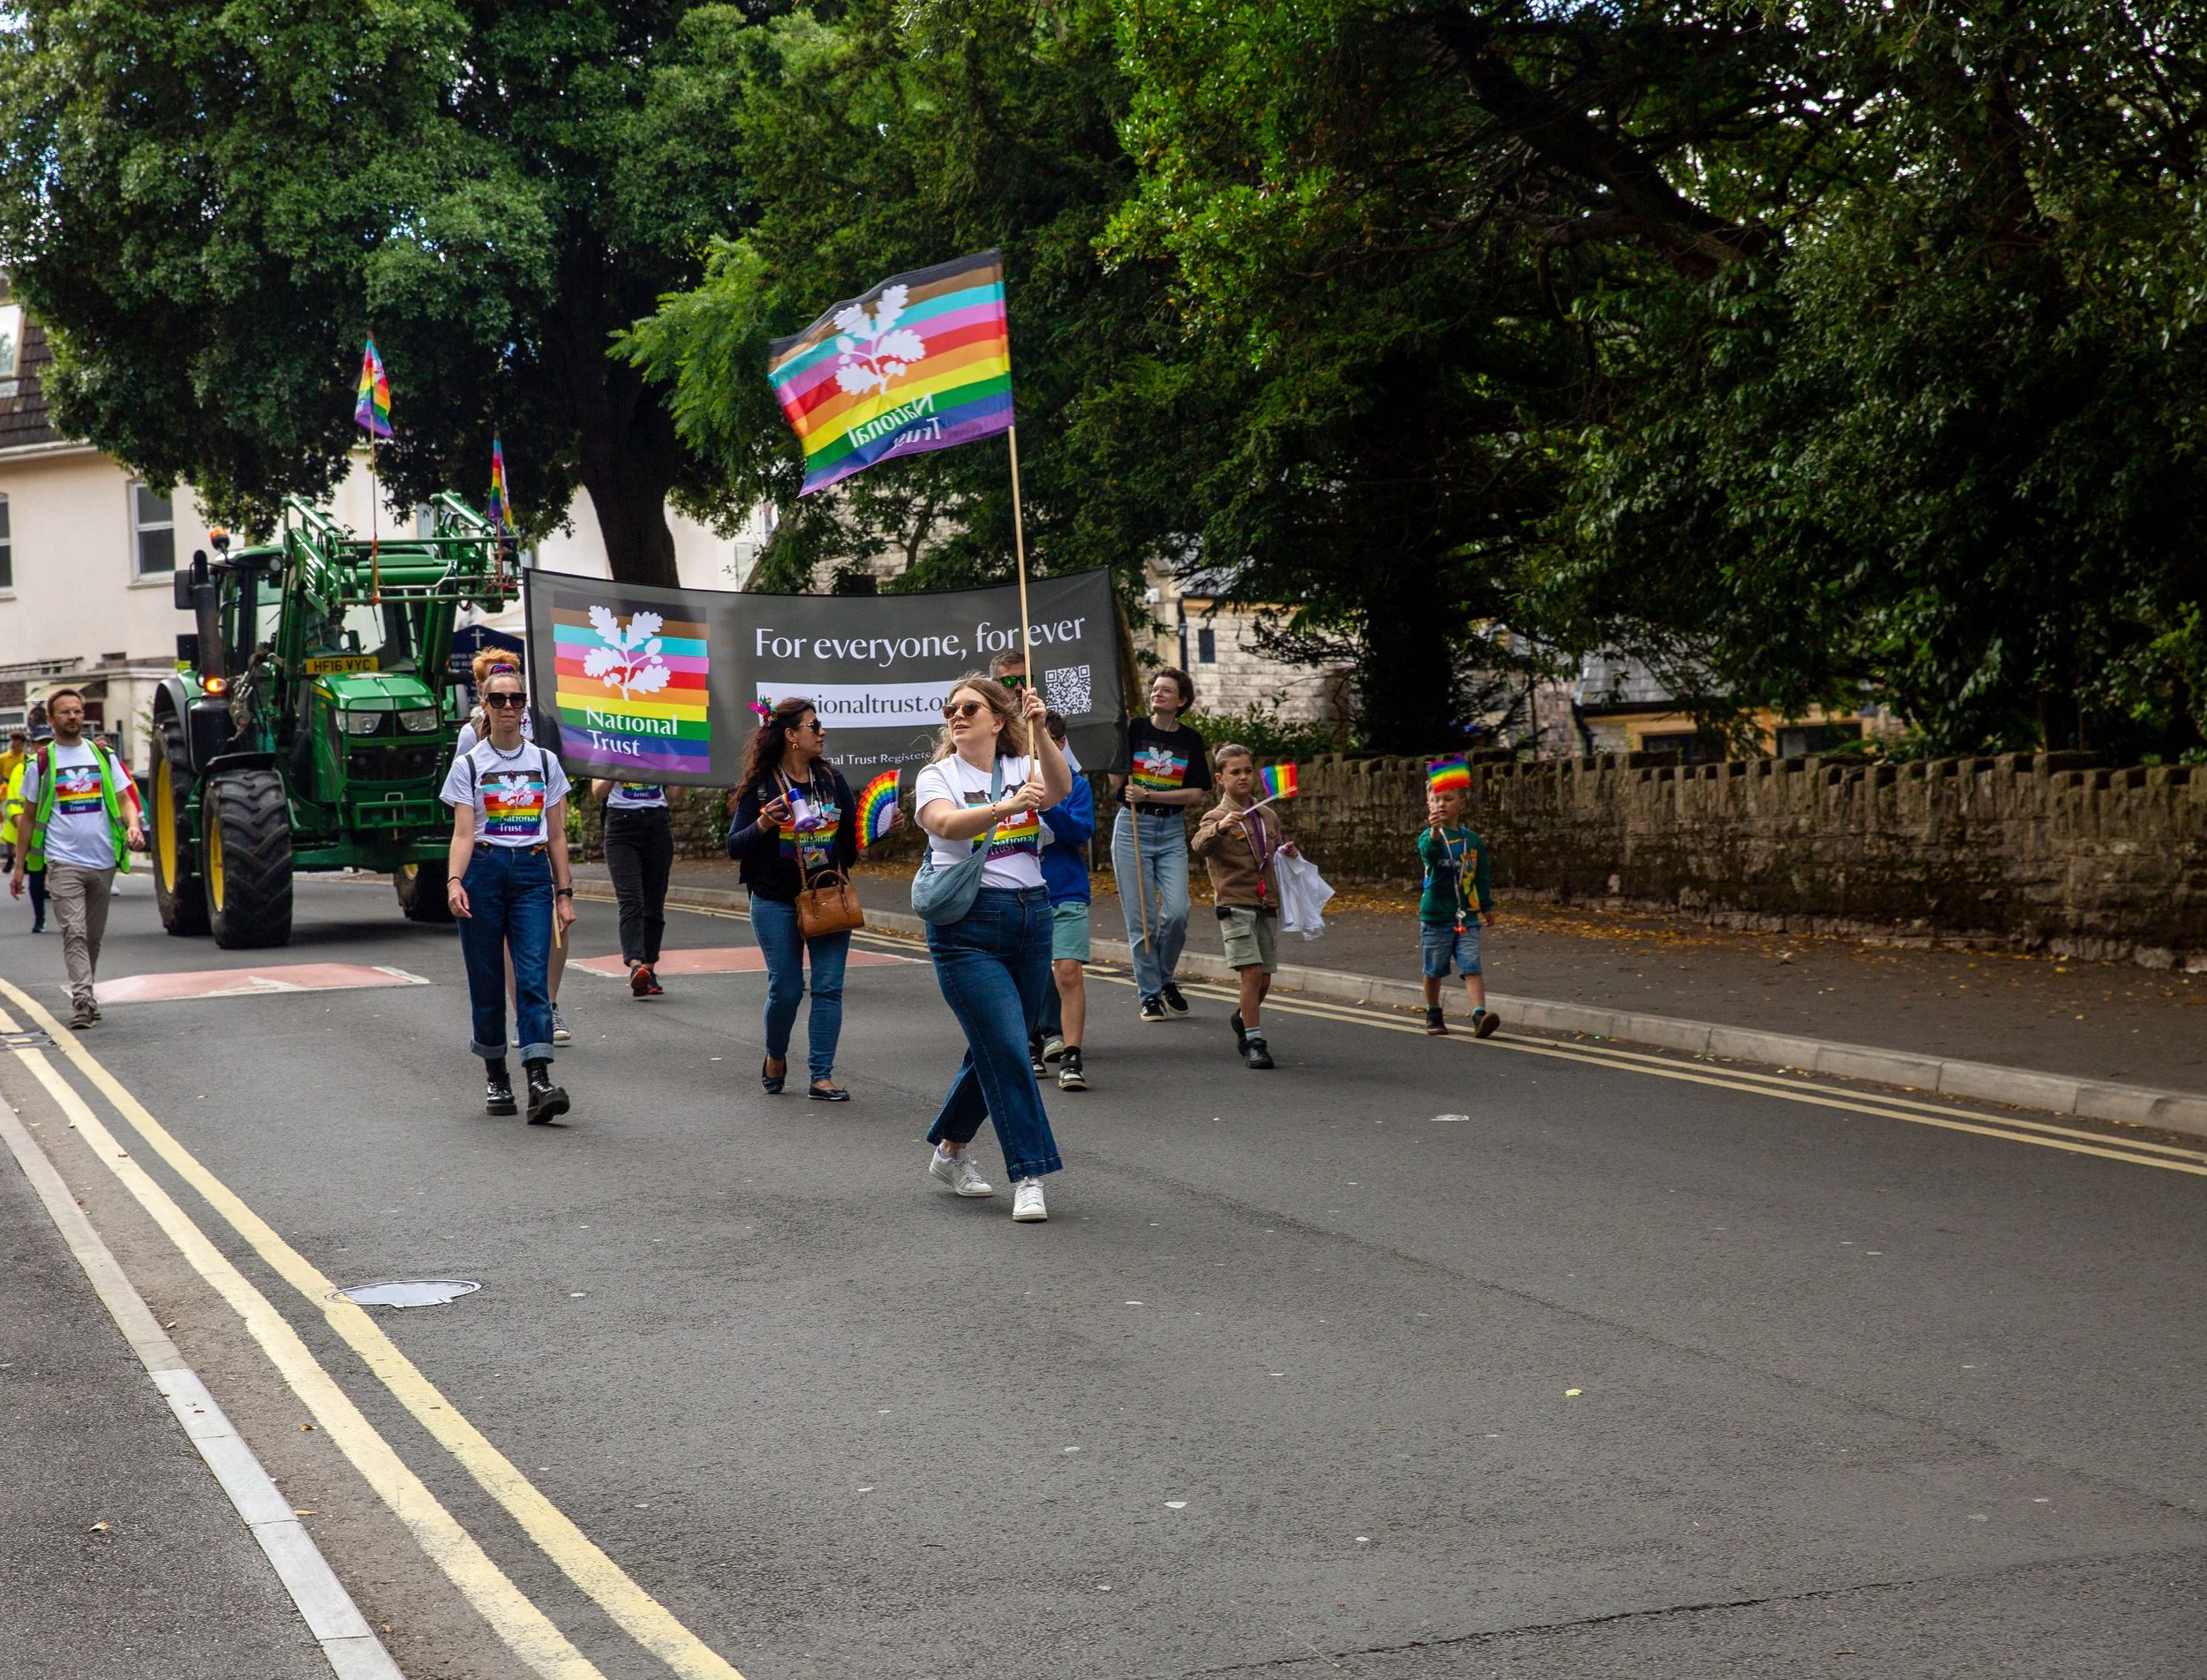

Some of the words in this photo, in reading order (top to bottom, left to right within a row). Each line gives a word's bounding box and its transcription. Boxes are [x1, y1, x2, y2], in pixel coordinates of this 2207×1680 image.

[756, 628, 807, 659] For
[813, 634, 967, 667] everyone,
[975, 622, 1019, 653] for
[1028, 617, 1085, 646] ever
[313, 659, 343, 672] HF16
[346, 659, 371, 671] VYC
[585, 705, 678, 735] National
[586, 729, 641, 757] Trust
[847, 754, 878, 765] Trust
[500, 813, 538, 822] National
[498, 823, 523, 832] Trust
[990, 832, 1035, 848] National
